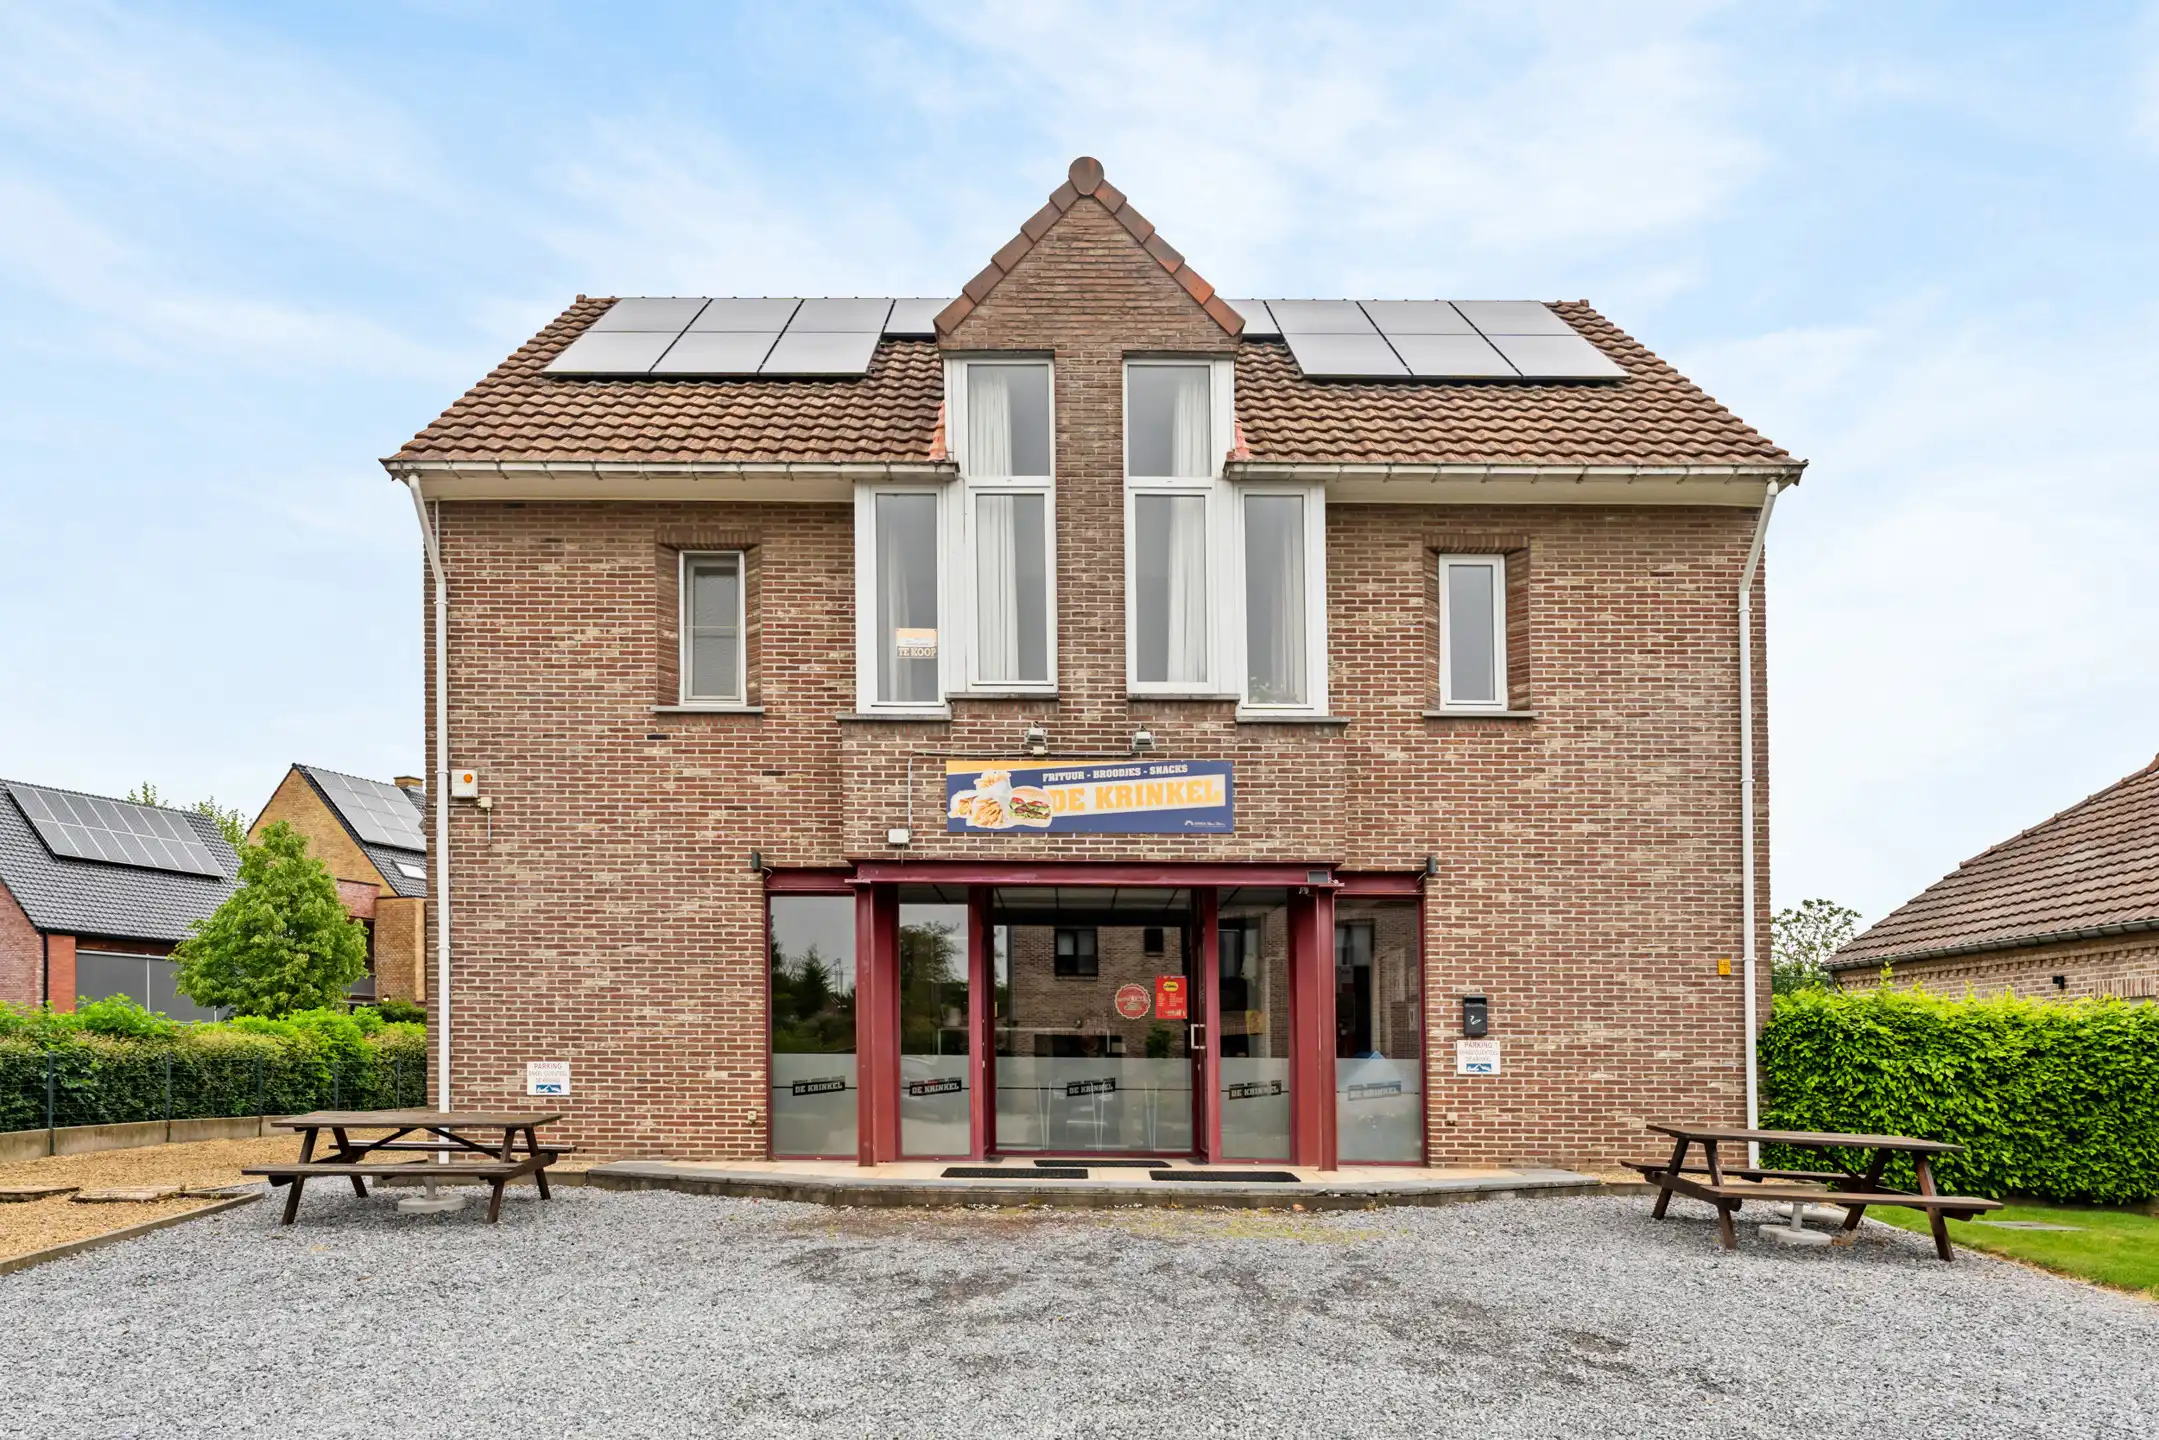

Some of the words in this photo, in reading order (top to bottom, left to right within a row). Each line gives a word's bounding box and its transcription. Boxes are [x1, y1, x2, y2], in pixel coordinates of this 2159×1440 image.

[910, 647, 937, 657] KOOP
[1042, 771, 1085, 782] FRITUUR
[1093, 767, 1141, 779] BROODJES
[1149, 764, 1188, 775] SNACKS
[1048, 787, 1085, 813] DE
[1095, 779, 1222, 810] KRINKEL
[1464, 1041, 1493, 1049] PARKING
[533, 1062, 562, 1070] PARKING
[794, 1085, 806, 1094] DE
[807, 1081, 843, 1092] KRINKEL
[911, 1086, 923, 1095] DE
[924, 1082, 960, 1093] KRINKEL
[1068, 1086, 1080, 1095] DE
